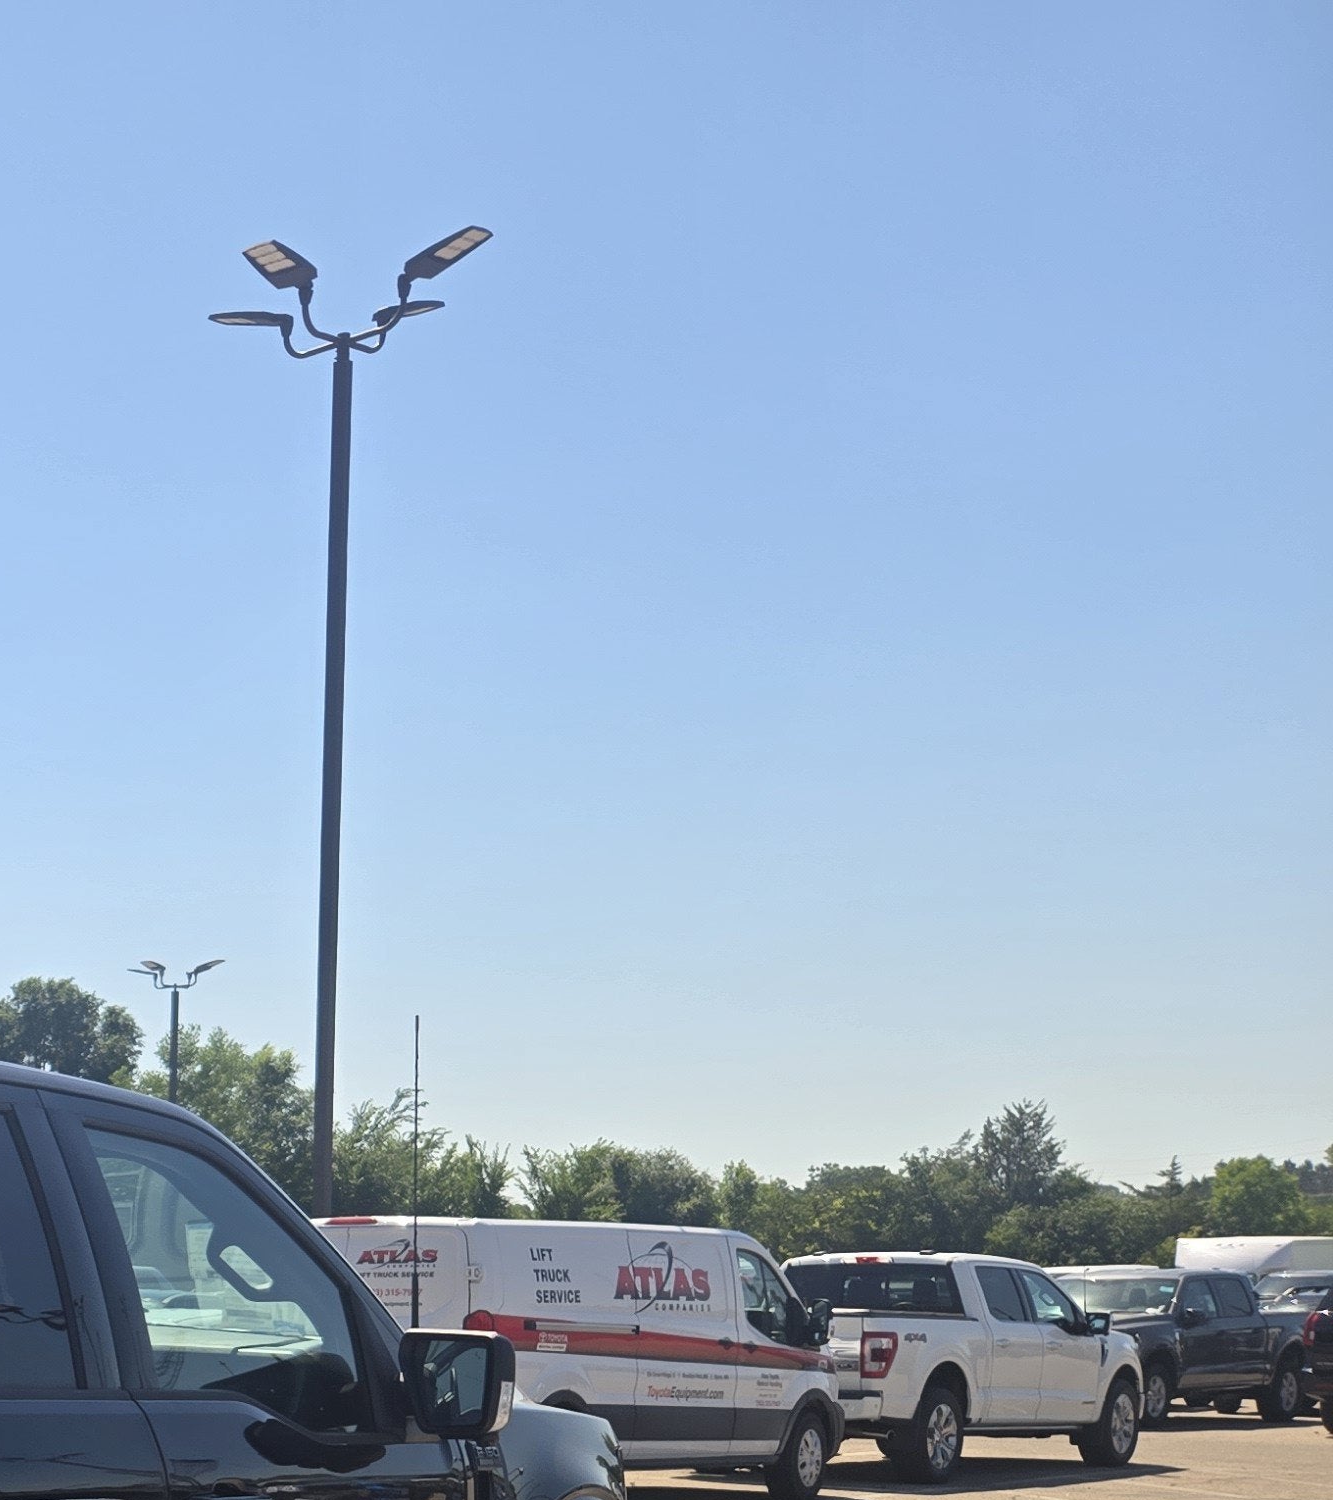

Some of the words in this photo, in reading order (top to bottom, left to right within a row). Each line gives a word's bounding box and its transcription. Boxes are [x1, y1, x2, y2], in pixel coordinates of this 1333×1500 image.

[356, 1249, 438, 1265] ATLAS
[530, 1248, 553, 1262] LIFT
[534, 1268, 571, 1283] TRUCK
[613, 1265, 711, 1301] ATLAS
[536, 1289, 581, 1304] SERVICE
[655, 1302, 711, 1312] COMPANIES
[648, 1385, 724, 1401] ToyotaEquipment.com
